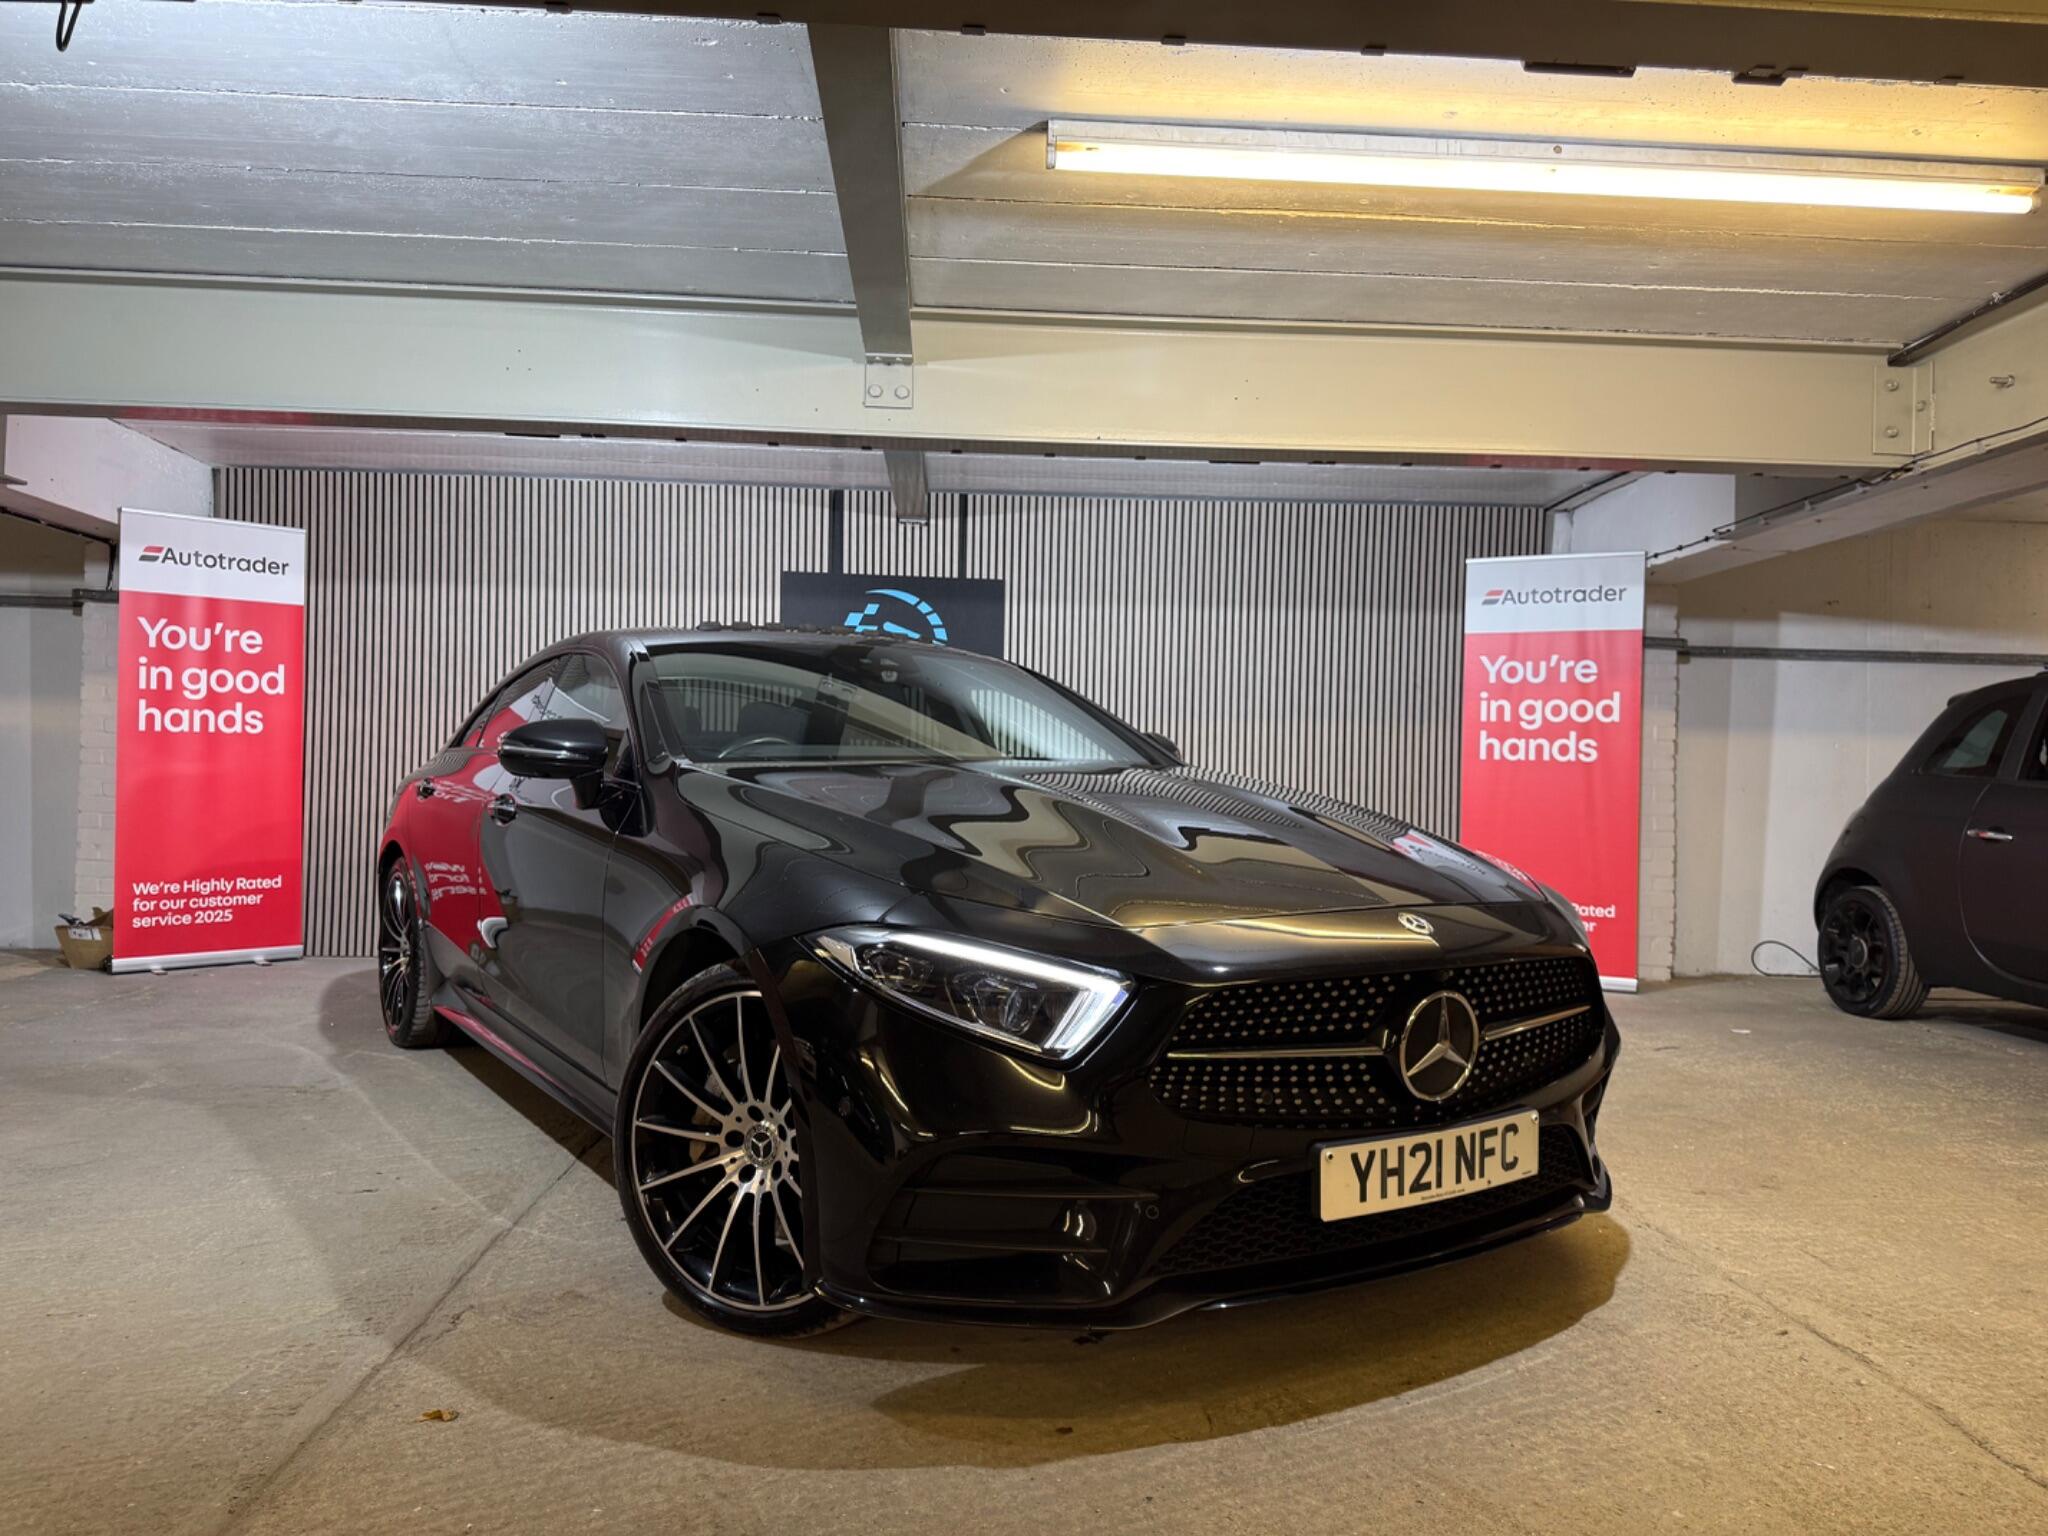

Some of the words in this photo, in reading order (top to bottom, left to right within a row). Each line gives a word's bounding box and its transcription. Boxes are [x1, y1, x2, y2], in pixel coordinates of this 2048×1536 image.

[161, 547, 289, 576] Autotrader
[1502, 585, 1627, 605] Autotrader
[136, 615, 263, 655] You're
[138, 656, 173, 691] in
[181, 664, 286, 700] good
[1479, 654, 1598, 684] You're
[138, 699, 263, 735] hands
[1480, 691, 1512, 722] in
[1518, 691, 1620, 730] good
[1479, 730, 1598, 762] hands
[132, 882, 180, 896] We're
[183, 878, 234, 895] Highly
[236, 875, 282, 890] Rated
[132, 897, 157, 912] for
[159, 898, 187, 910] our
[189, 892, 263, 908] customer
[131, 911, 191, 928] service
[194, 909, 233, 924] 2025
[1351, 1138, 1443, 1203] YH21
[1455, 1122, 1520, 1186] NFC
